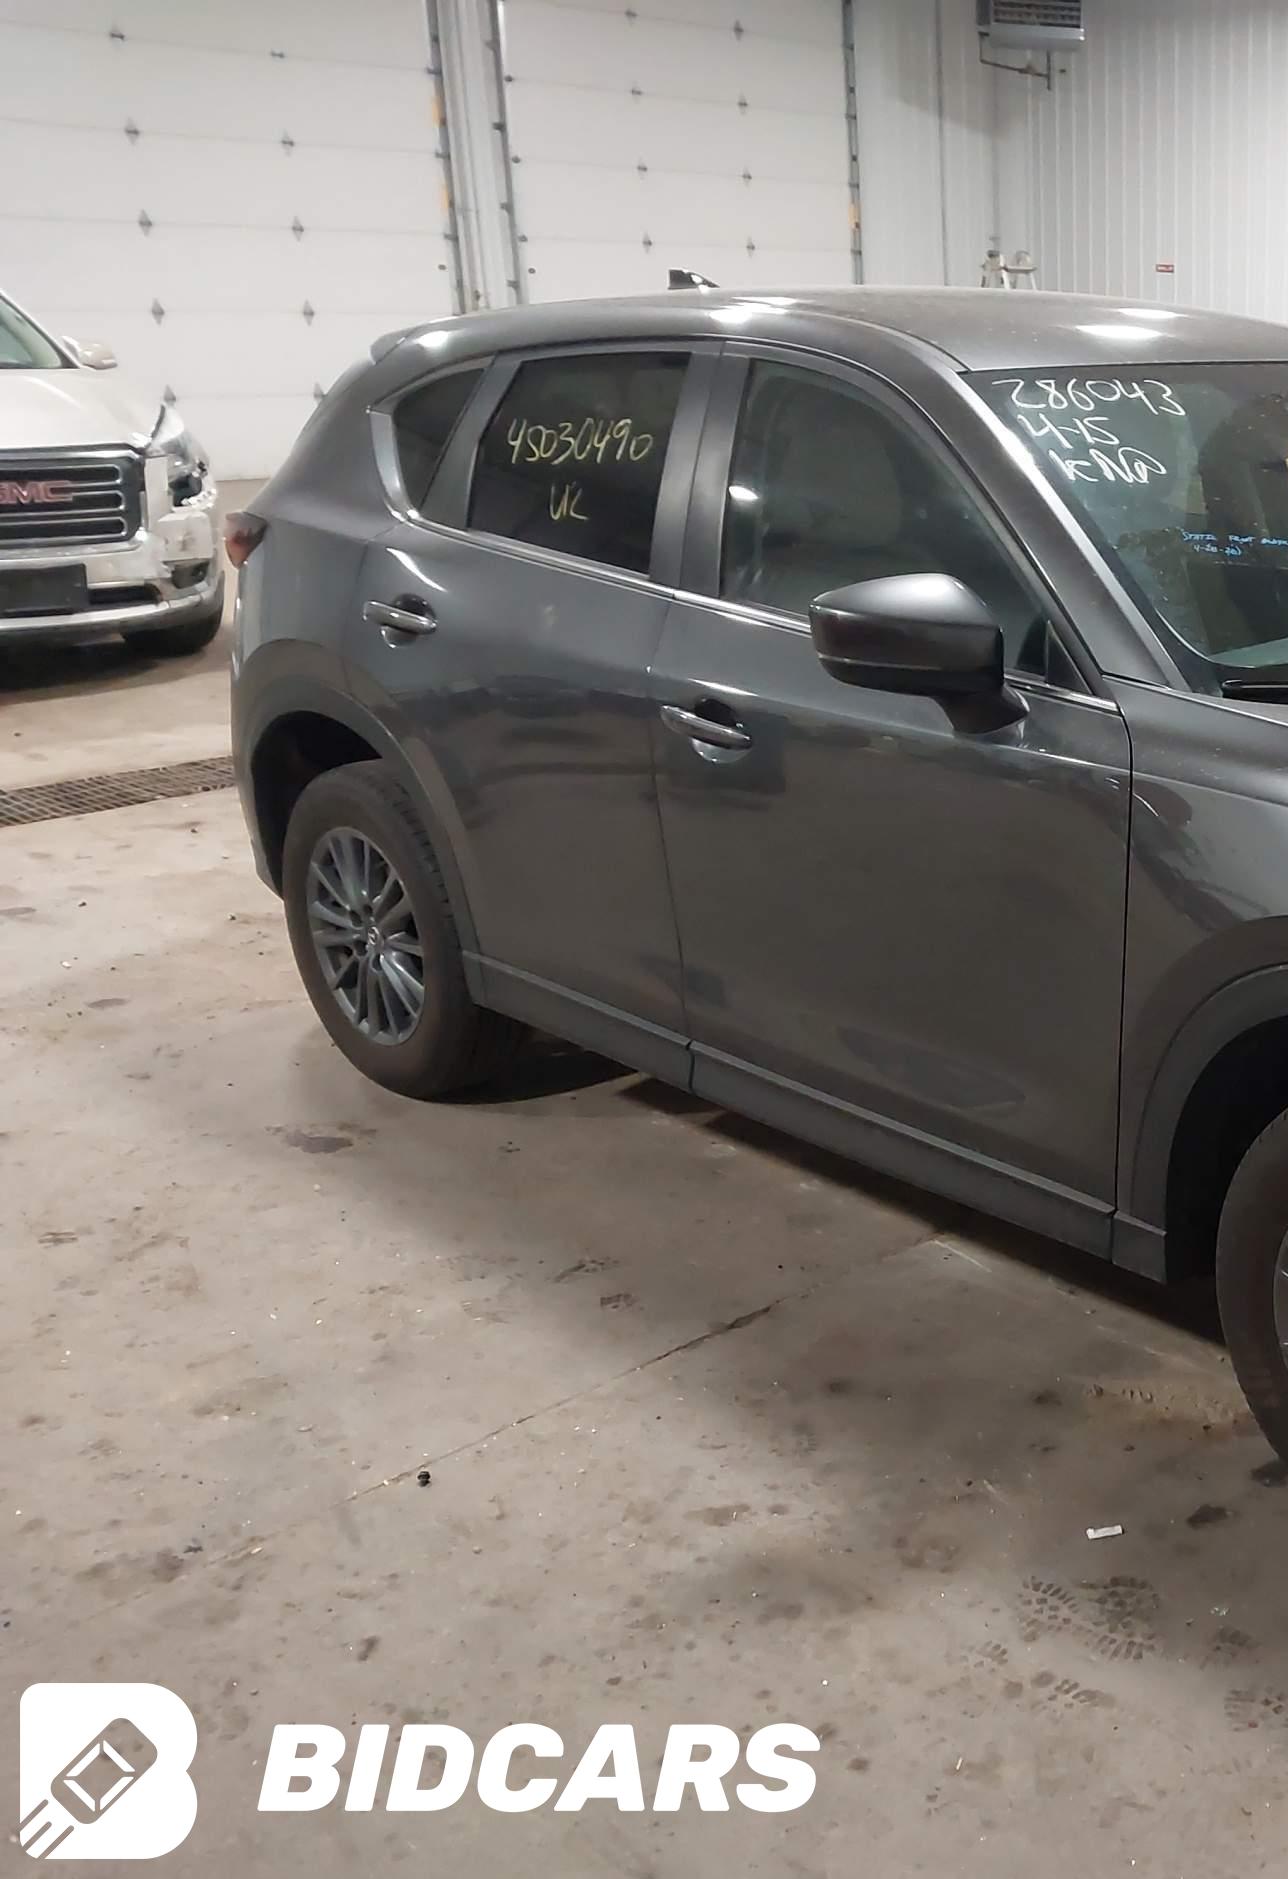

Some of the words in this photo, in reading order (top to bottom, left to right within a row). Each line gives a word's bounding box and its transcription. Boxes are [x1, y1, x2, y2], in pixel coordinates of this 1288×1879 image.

[991, 377, 1186, 416] 286043
[507, 417, 654, 464] 45030490
[0, 480, 73, 504] MC
